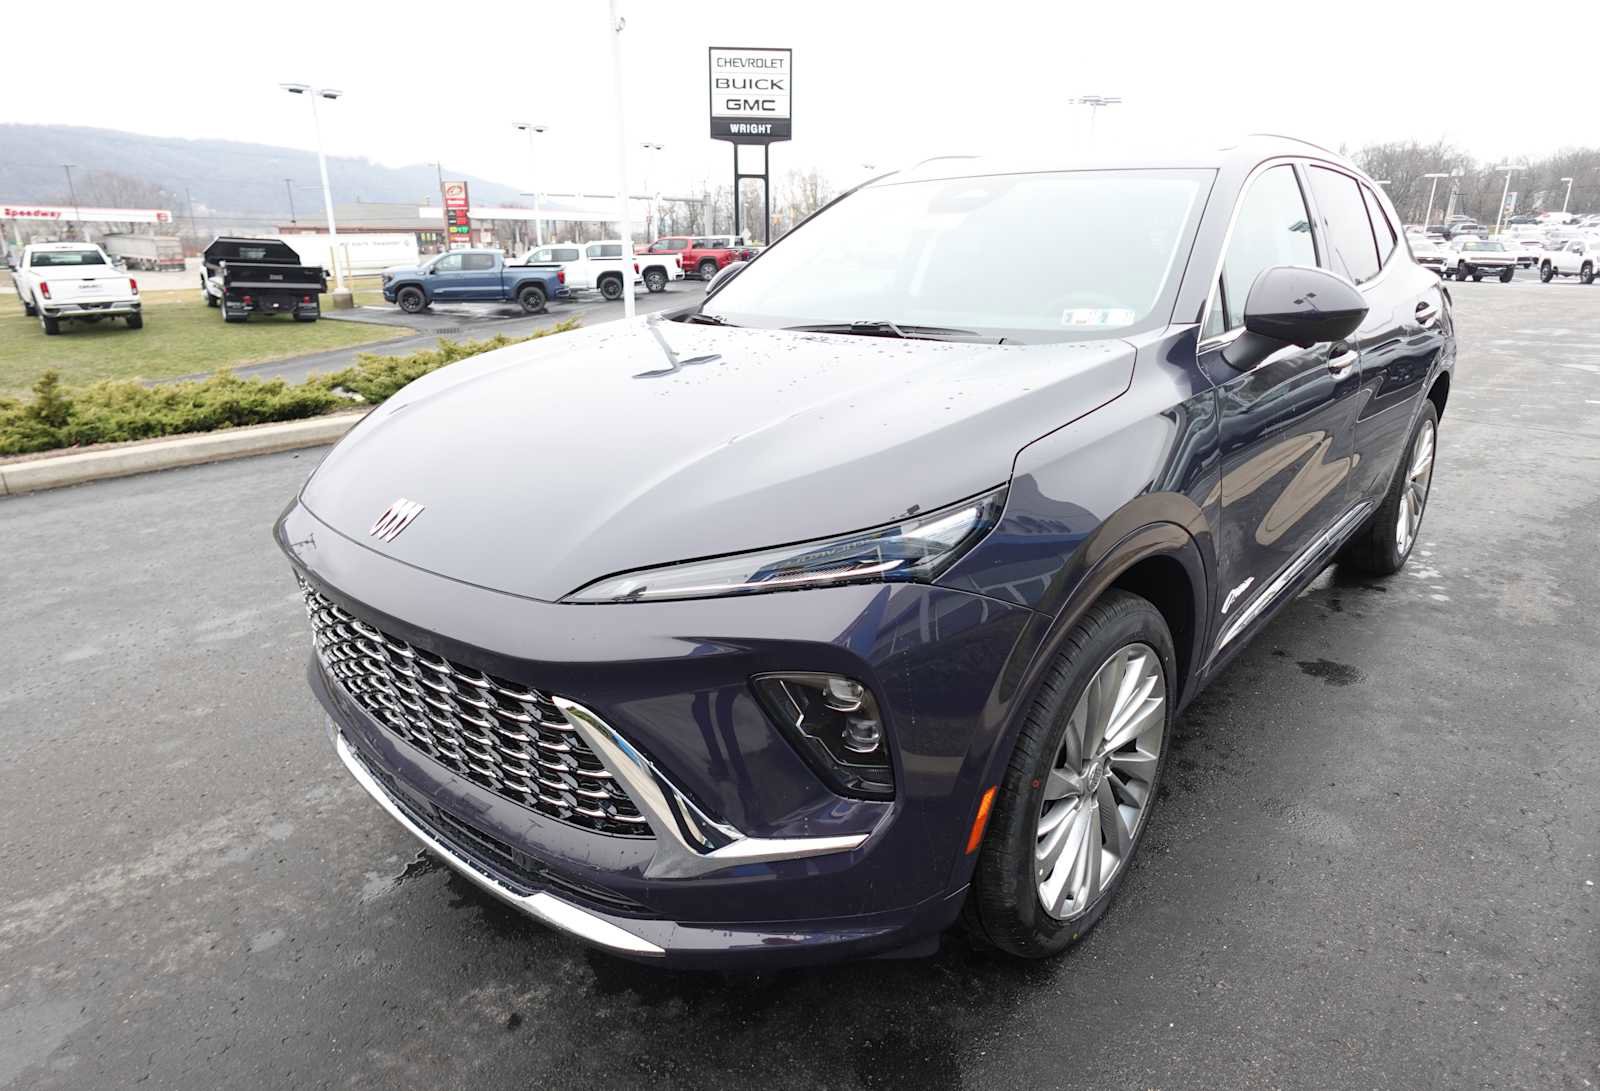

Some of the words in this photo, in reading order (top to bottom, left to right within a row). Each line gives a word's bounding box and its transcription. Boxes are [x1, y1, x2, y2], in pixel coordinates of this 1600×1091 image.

[716, 57, 784, 69] CHEVROLET
[715, 78, 784, 90] BUICK
[726, 98, 776, 111] GMC
[729, 123, 772, 134] WRIGHT
[4, 208, 61, 219] Speedway
